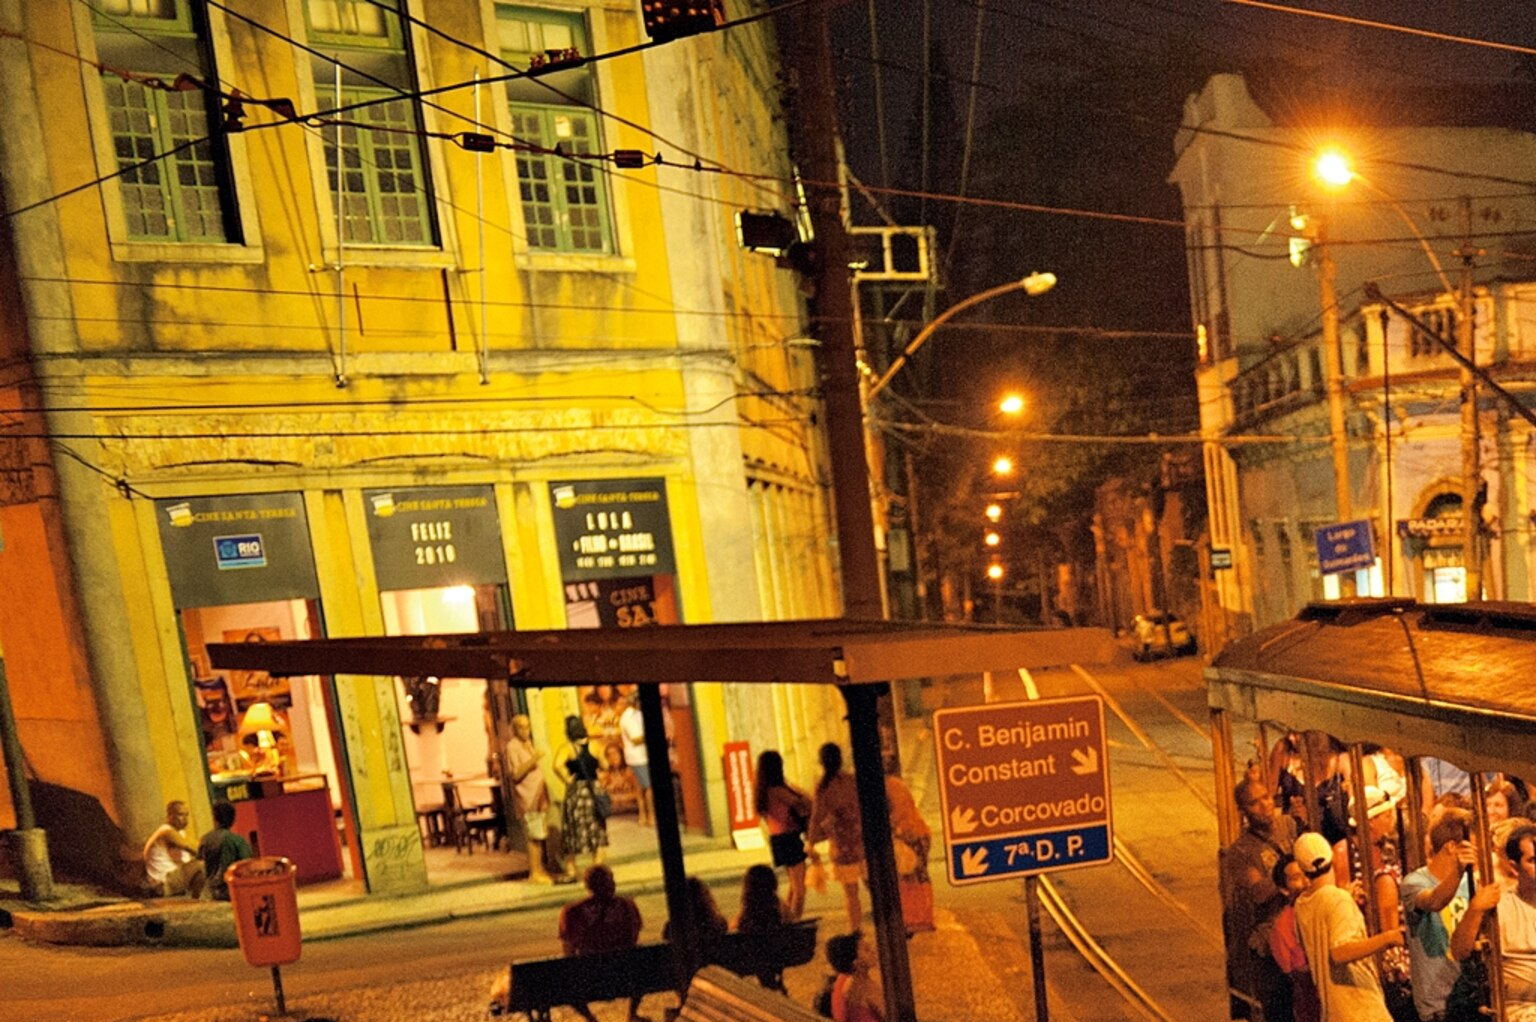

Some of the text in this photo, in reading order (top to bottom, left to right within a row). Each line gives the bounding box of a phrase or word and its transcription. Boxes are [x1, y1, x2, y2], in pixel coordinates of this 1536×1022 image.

[411, 521, 452, 541] FELIZ
[586, 511, 633, 531] LULA
[238, 541, 261, 554] RIO
[415, 544, 456, 565] 2010
[944, 717, 1090, 750] C. Benjamin
[949, 755, 1057, 786] Constant
[980, 793, 1105, 827] Corcovado
